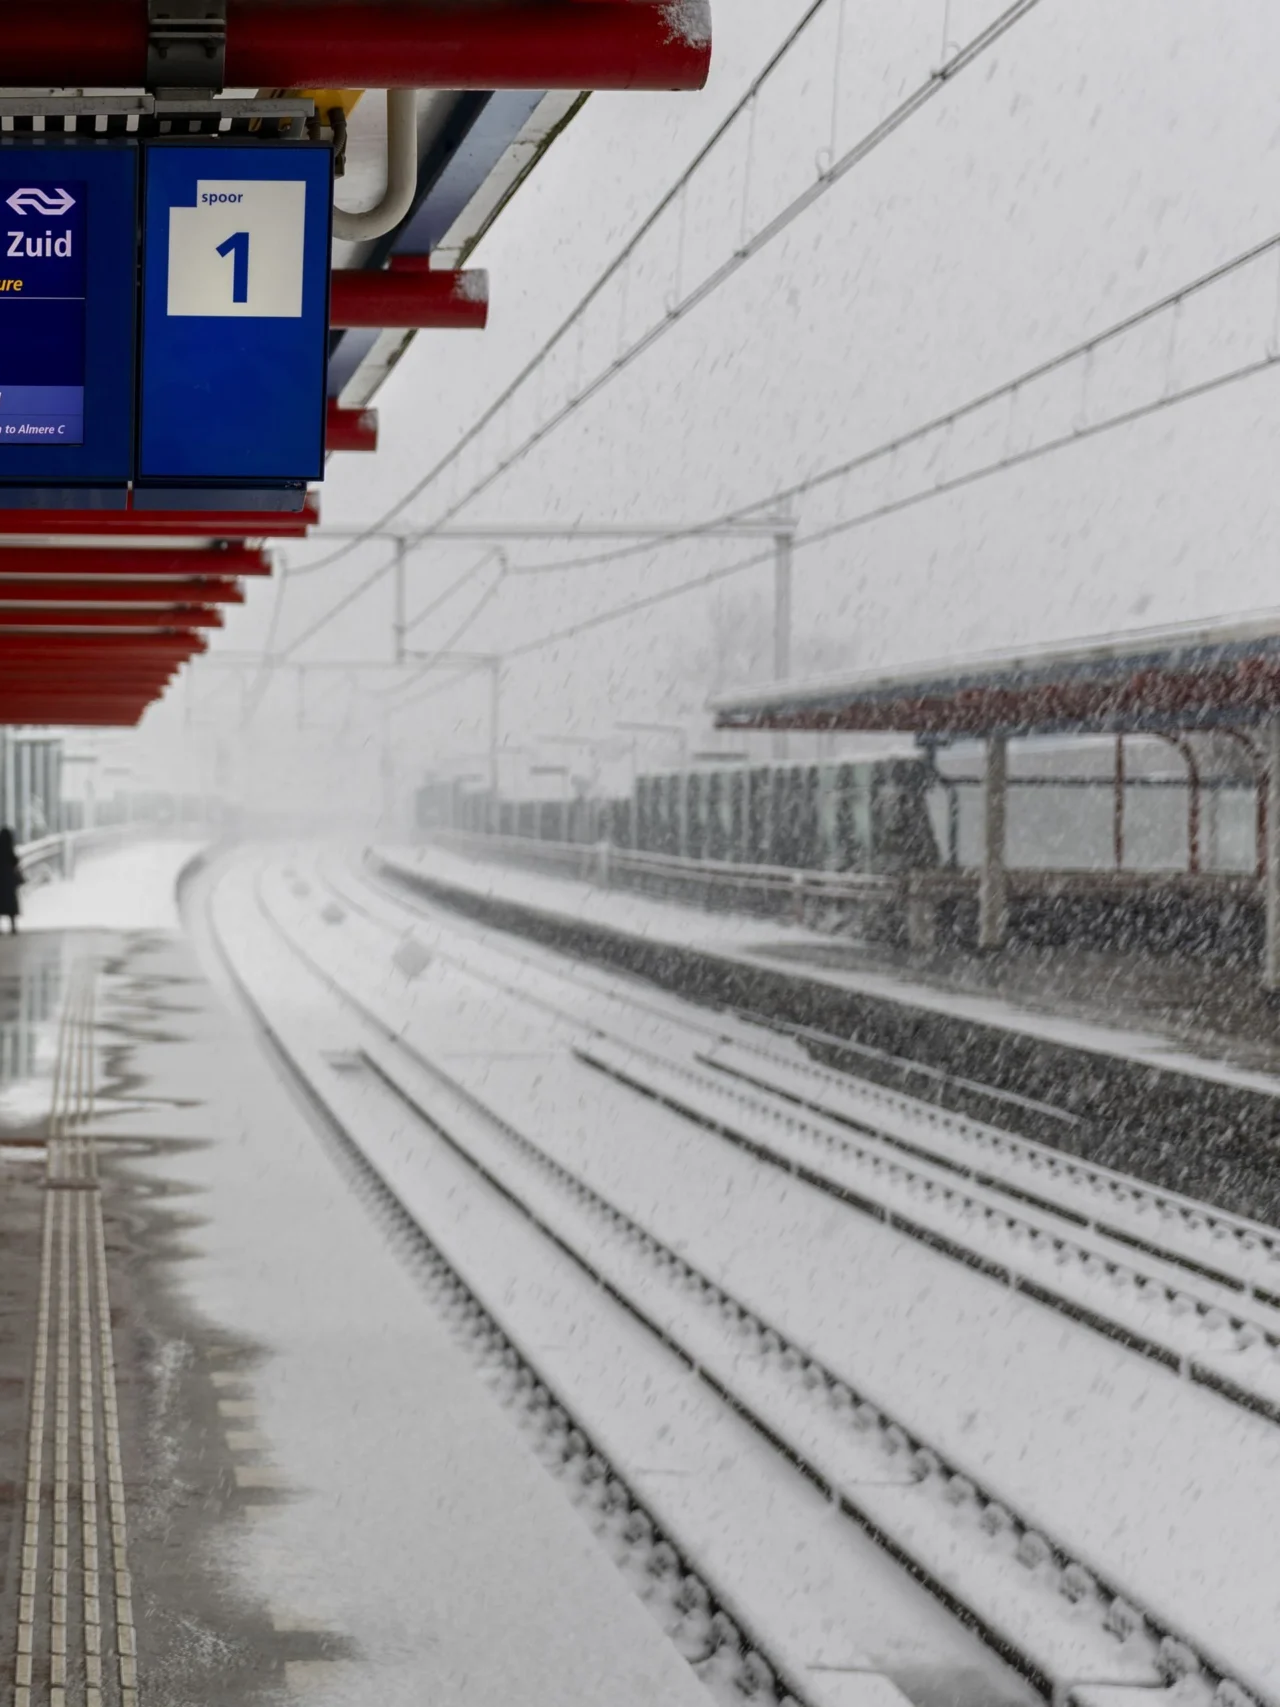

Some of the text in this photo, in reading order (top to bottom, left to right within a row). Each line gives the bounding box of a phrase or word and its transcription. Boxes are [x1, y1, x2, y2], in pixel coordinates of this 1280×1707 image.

[201, 192, 244, 205] spoor
[6, 229, 73, 258] Zuid
[215, 231, 250, 304] 1
[4, 425, 17, 435] to
[17, 424, 56, 435] Almere
[56, 424, 66, 435] C
